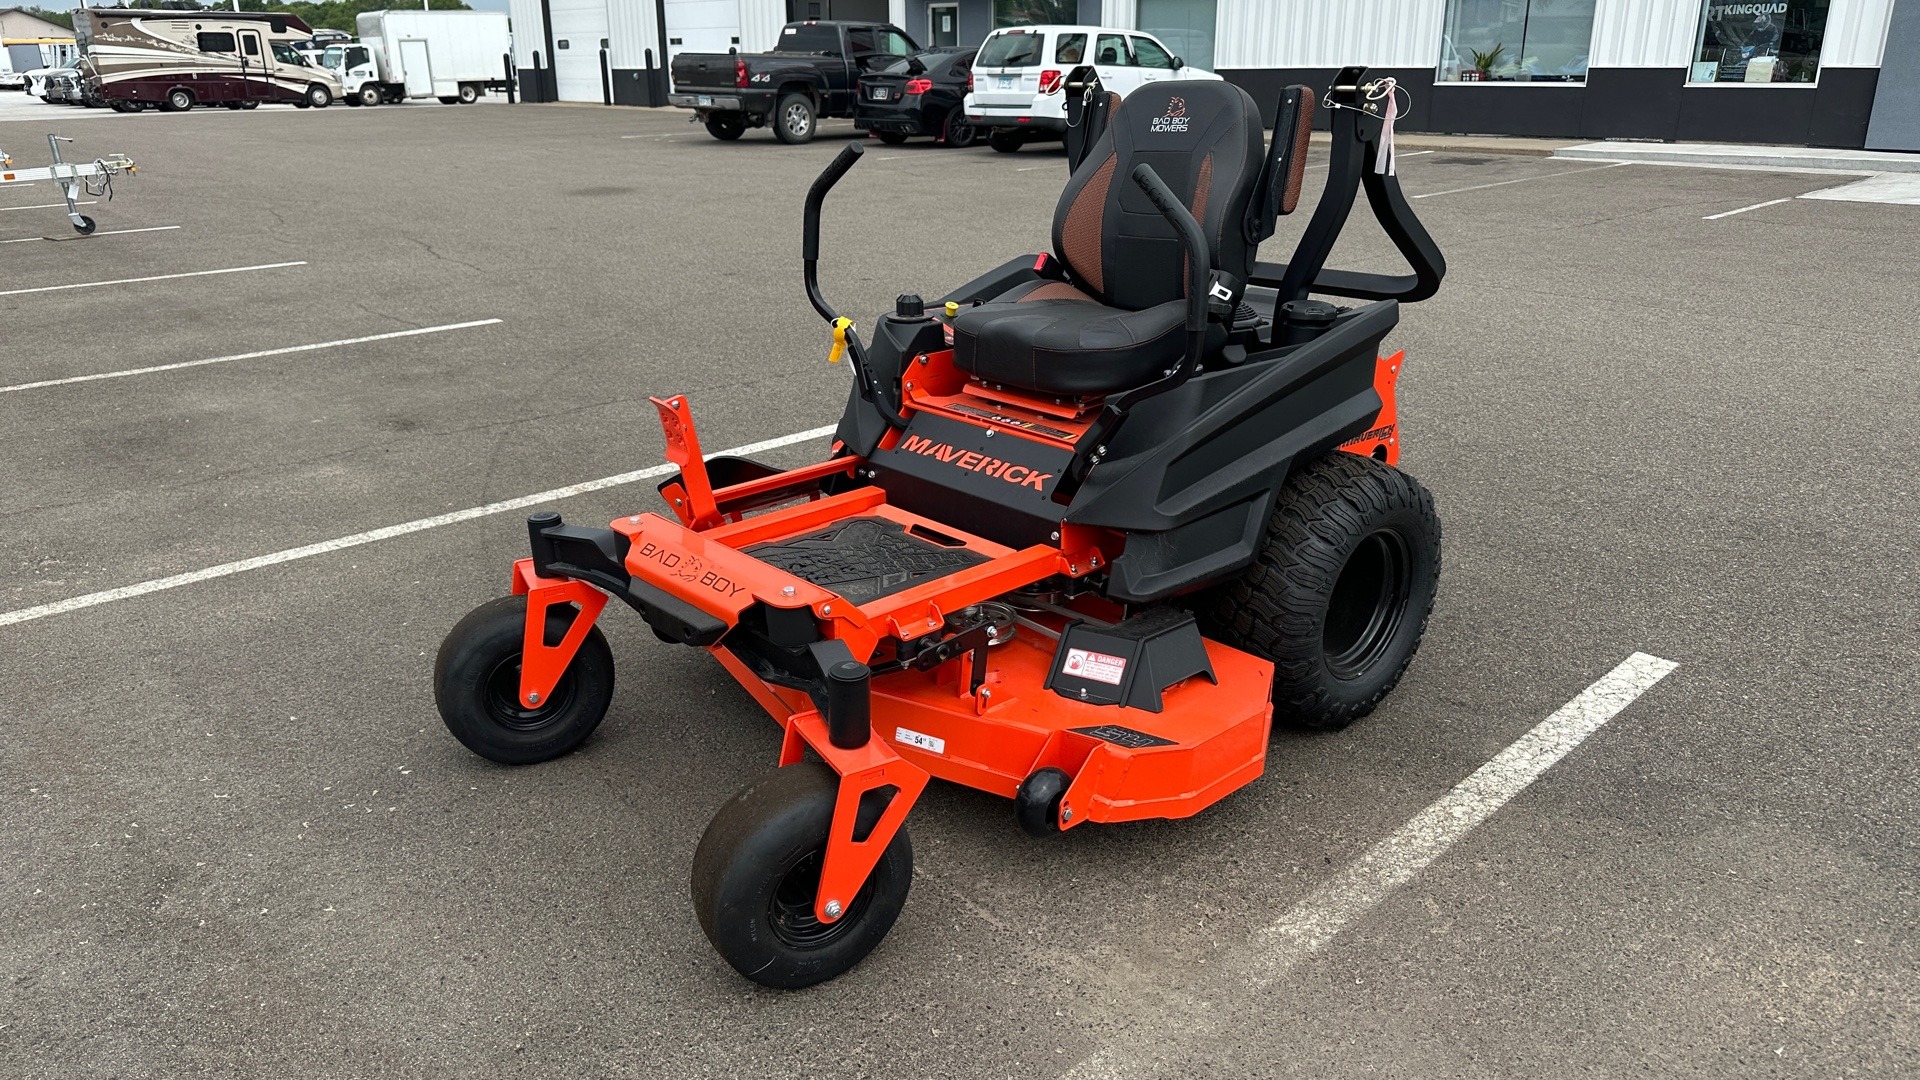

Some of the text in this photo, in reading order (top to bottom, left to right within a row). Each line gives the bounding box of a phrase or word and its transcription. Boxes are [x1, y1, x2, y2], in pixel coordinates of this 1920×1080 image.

[1724, 3, 1788, 16] KINGQUAD
[1152, 116, 1191, 125] BAD BOY
[1150, 124, 1189, 132] MOWERS
[901, 434, 1054, 492] MAVERICK
[640, 542, 746, 598] BAD BOY
[1096, 655, 1124, 667] DANGER
